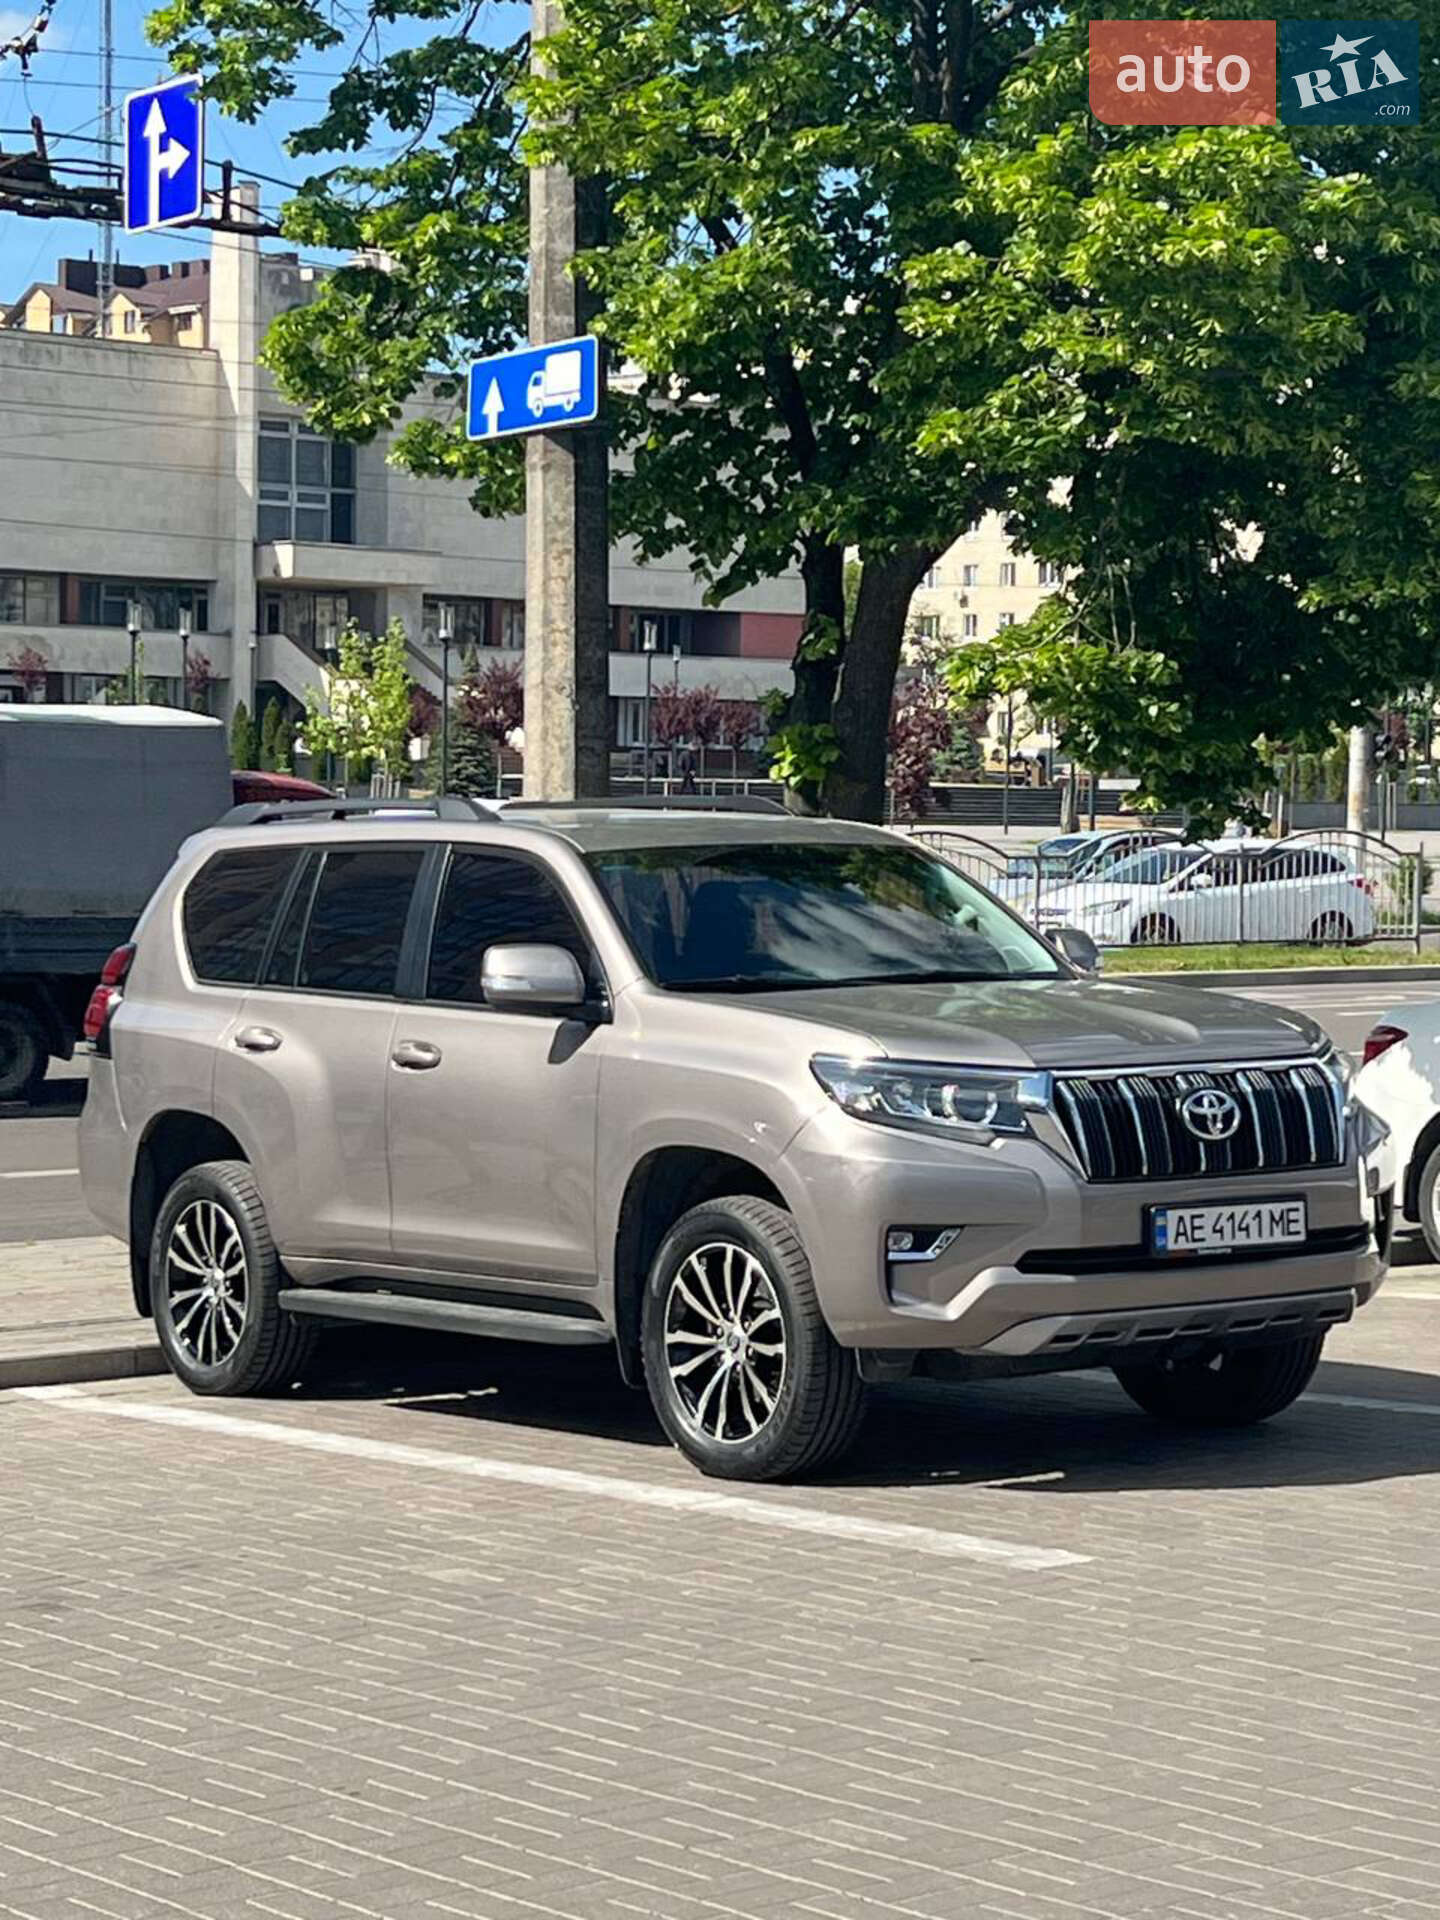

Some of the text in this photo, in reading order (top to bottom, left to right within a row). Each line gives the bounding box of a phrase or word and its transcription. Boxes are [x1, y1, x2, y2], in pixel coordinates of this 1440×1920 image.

[1173, 1207, 1302, 1244] AE 4141 ME
